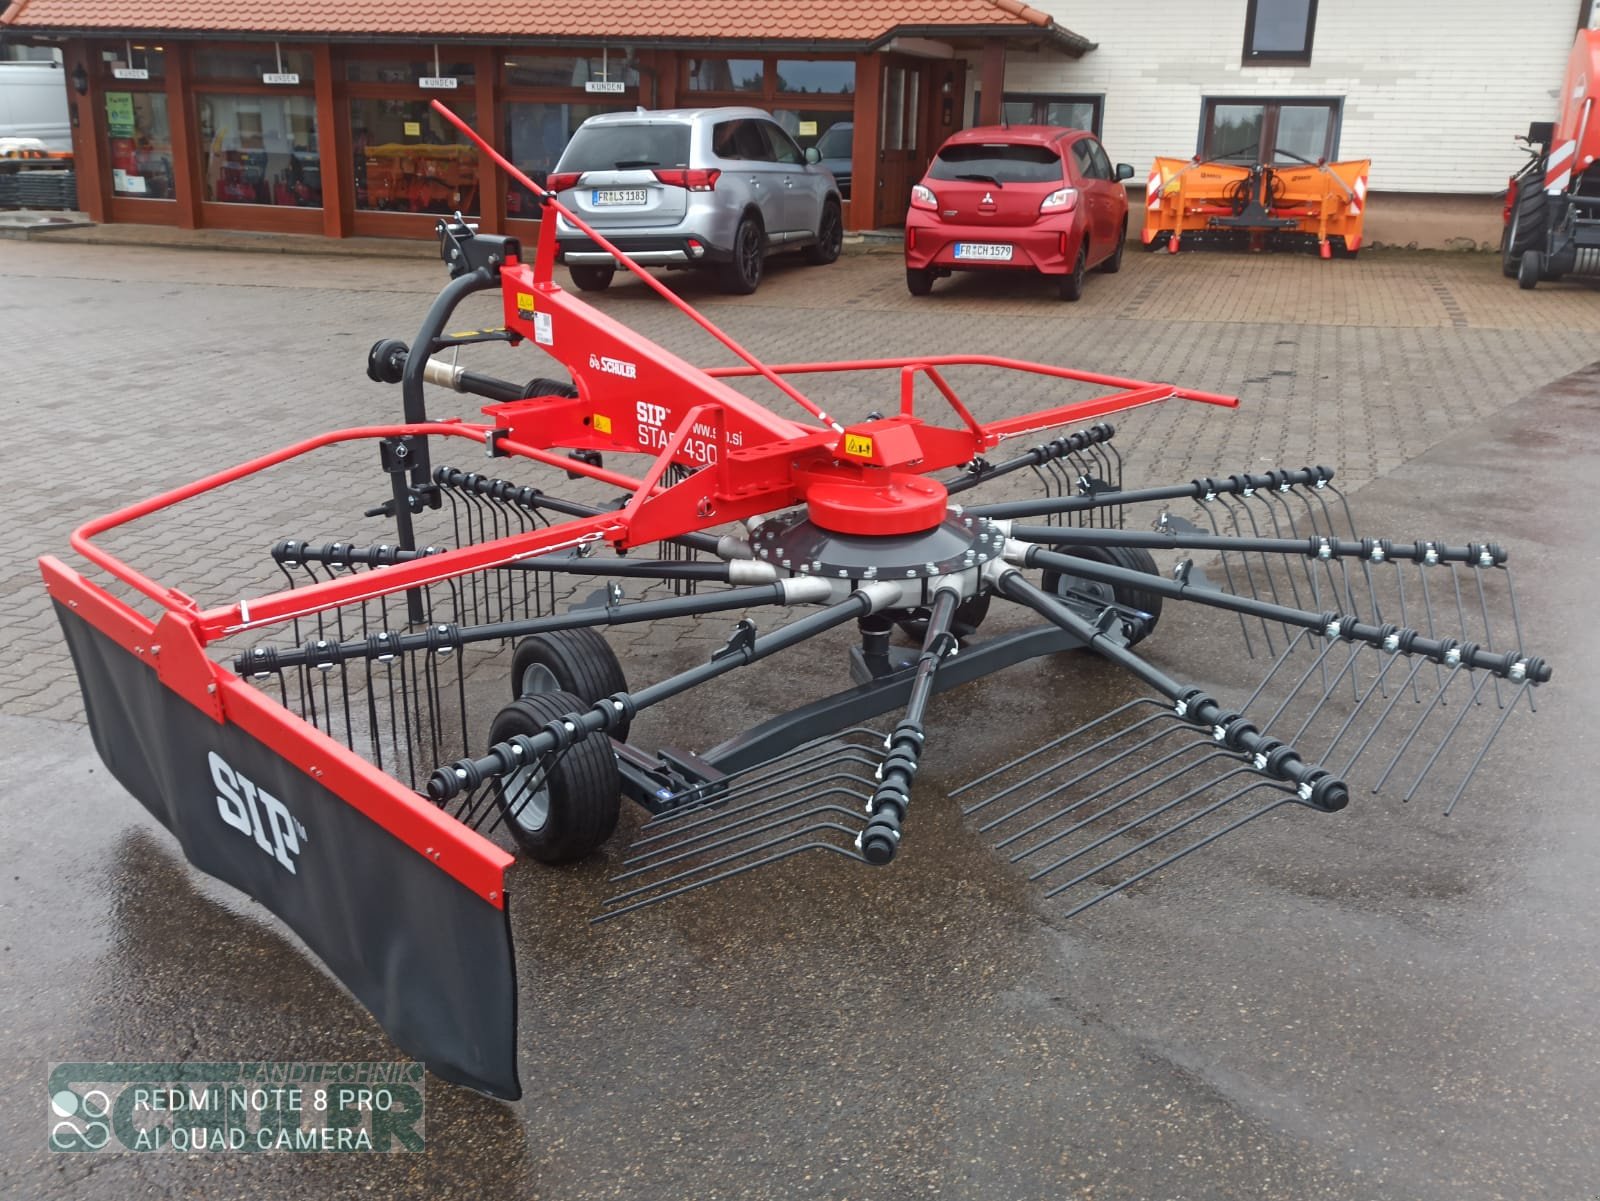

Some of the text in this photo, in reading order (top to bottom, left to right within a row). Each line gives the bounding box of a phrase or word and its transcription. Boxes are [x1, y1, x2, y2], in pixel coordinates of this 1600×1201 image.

[960, 245, 972, 255] FR
[990, 246, 1011, 257] 1579
[600, 356, 637, 379] SCHULER
[636, 401, 666, 427] SIP
[684, 438, 718, 465] 430
[207, 751, 300, 875] SIP
